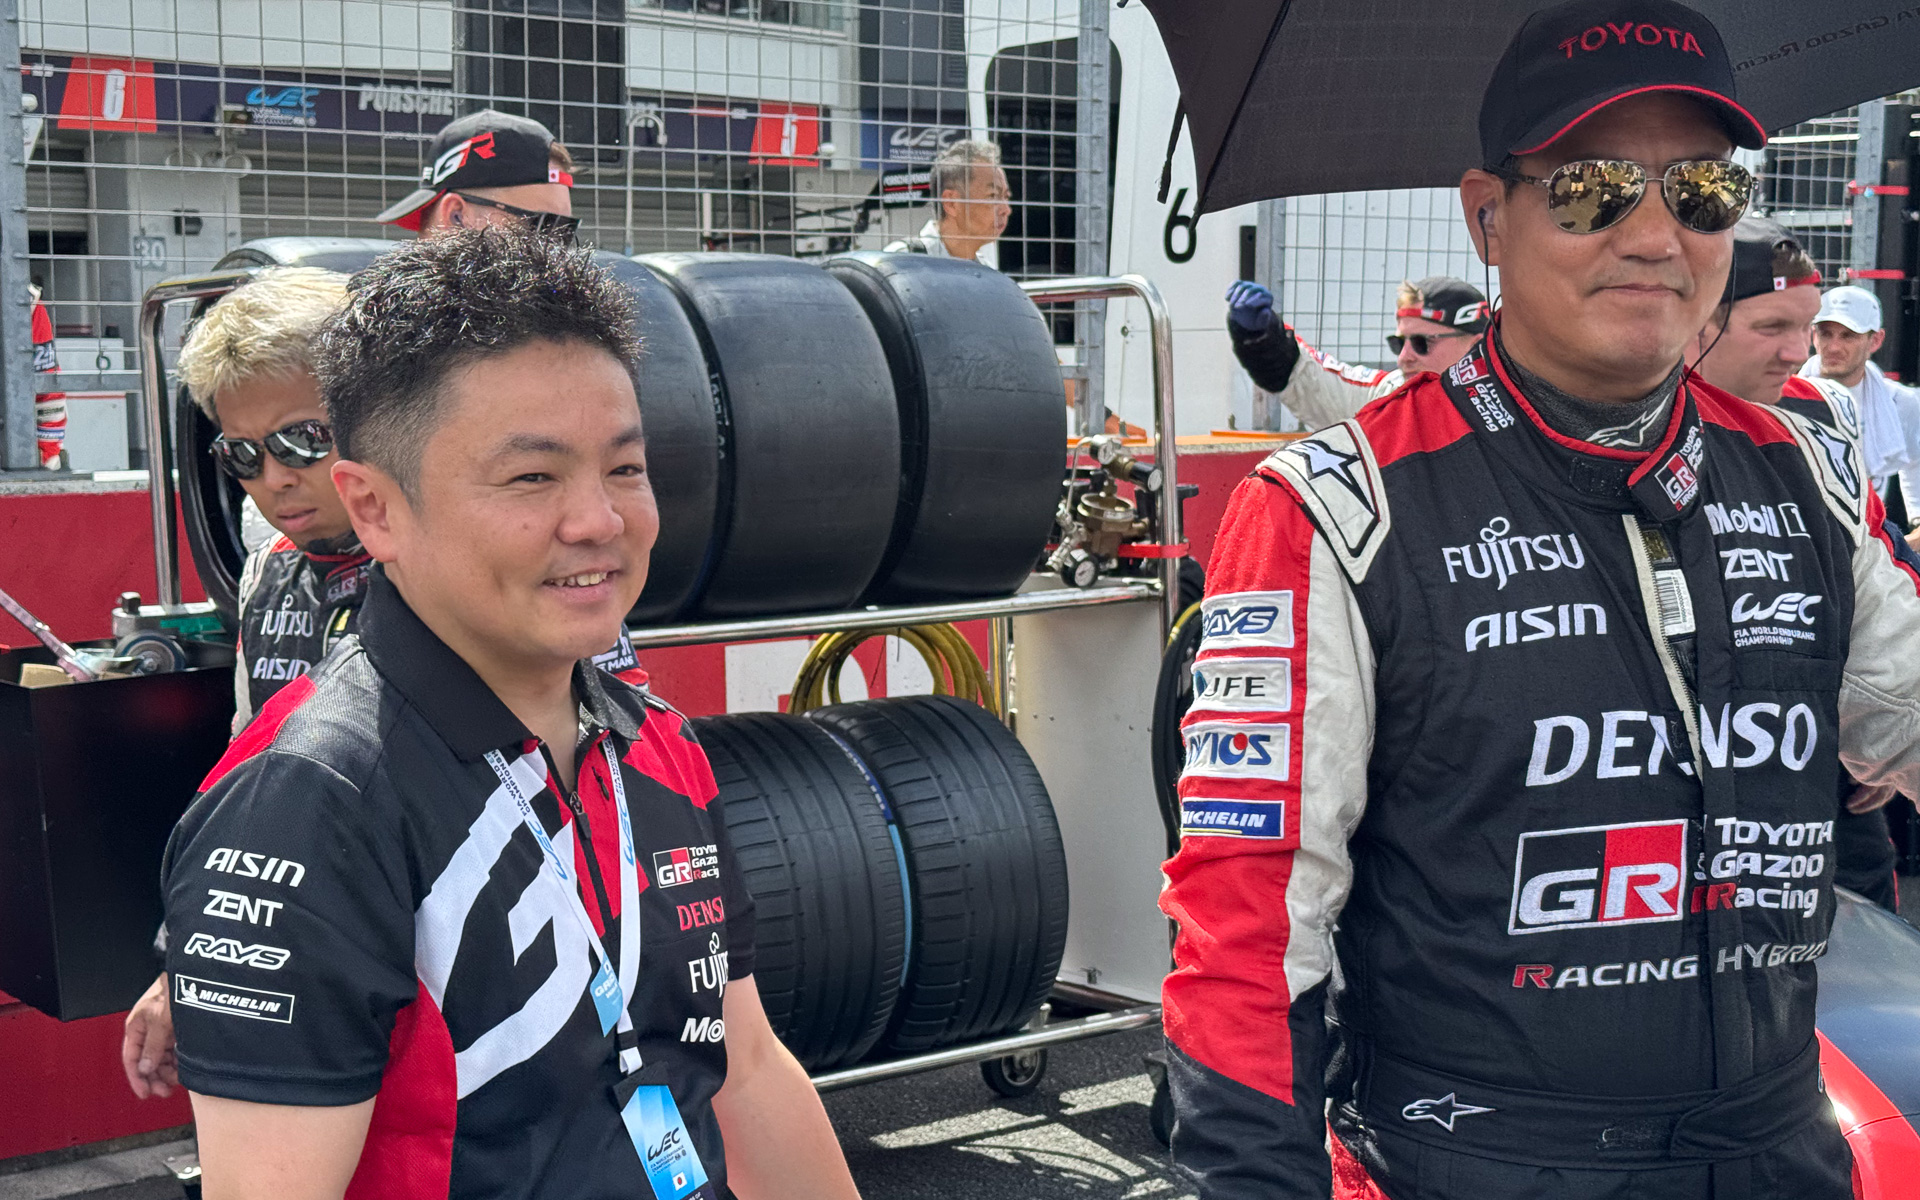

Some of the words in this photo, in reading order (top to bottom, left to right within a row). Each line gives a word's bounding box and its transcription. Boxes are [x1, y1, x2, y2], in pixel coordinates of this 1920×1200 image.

[1558, 22, 1705, 59] TOYOTA
[103, 69, 126, 121] 6
[432, 131, 497, 186] GR
[1163, 187, 1198, 264] 6
[1665, 465, 1694, 500] GR
[1703, 501, 1782, 538] Mobil
[1441, 516, 1586, 591] FUJITSU
[1719, 547, 1794, 582] ZENT
[1731, 592, 1823, 626] WEC
[1465, 603, 1608, 653] AISIN
[1733, 627, 1749, 639] FIA
[1750, 626, 1779, 636] WORLD
[1204, 676, 1266, 698] JFE
[491, 749, 531, 814] CHAMPIONSH
[493, 764, 517, 800] WORLD
[528, 820, 568, 880] WEC
[1714, 817, 1835, 847] TOYOTA
[203, 847, 306, 888] AISIN
[657, 861, 693, 885] GR
[1710, 849, 1825, 879] GAZOO
[203, 888, 284, 927] ZENT
[1518, 862, 1680, 925] GR
[1704, 882, 1820, 919] Racing
[676, 895, 725, 932] DENS
[184, 932, 291, 971] RAYS
[1512, 954, 1700, 990] RACING
[199, 989, 281, 1013] MICHELIN
[647, 1126, 681, 1162] WEC
